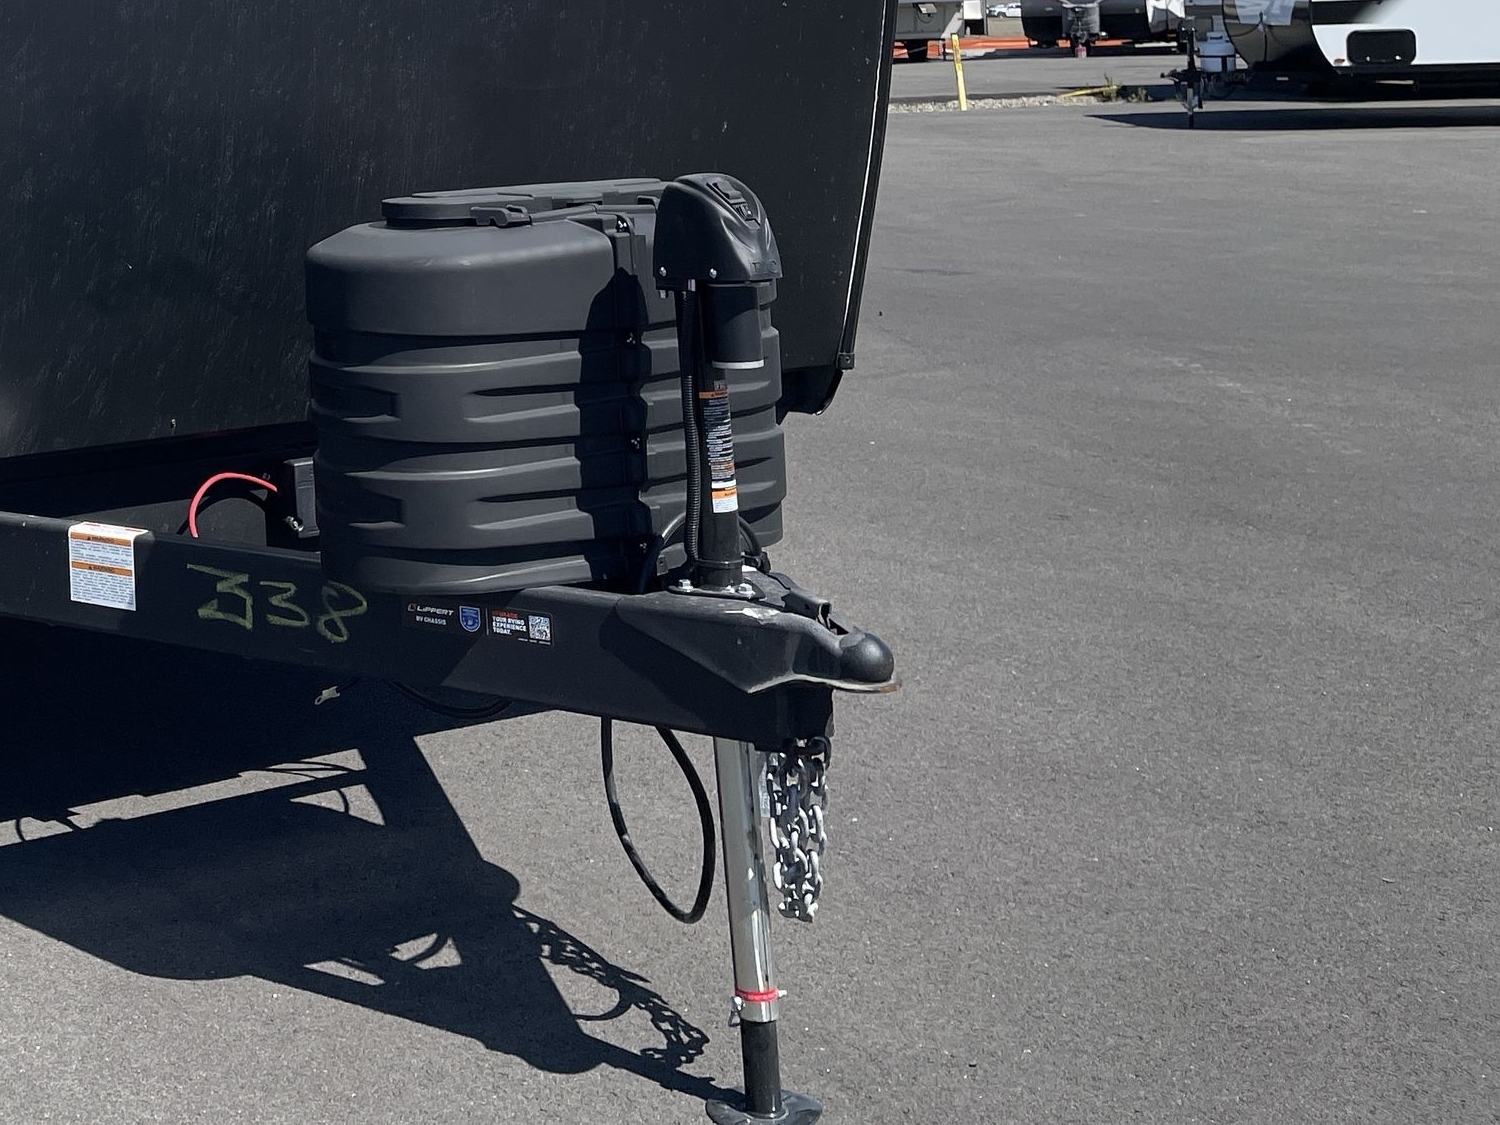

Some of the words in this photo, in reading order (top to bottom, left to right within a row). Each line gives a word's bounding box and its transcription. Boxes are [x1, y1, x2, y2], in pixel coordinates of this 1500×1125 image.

[186, 562, 368, 644] 338
[416, 615, 423, 623] RV
[423, 616, 447, 626] CHASSIS
[492, 616, 507, 624] YOUR
[507, 618, 525, 626] RVING
[492, 621, 527, 632] EXPERIENCE
